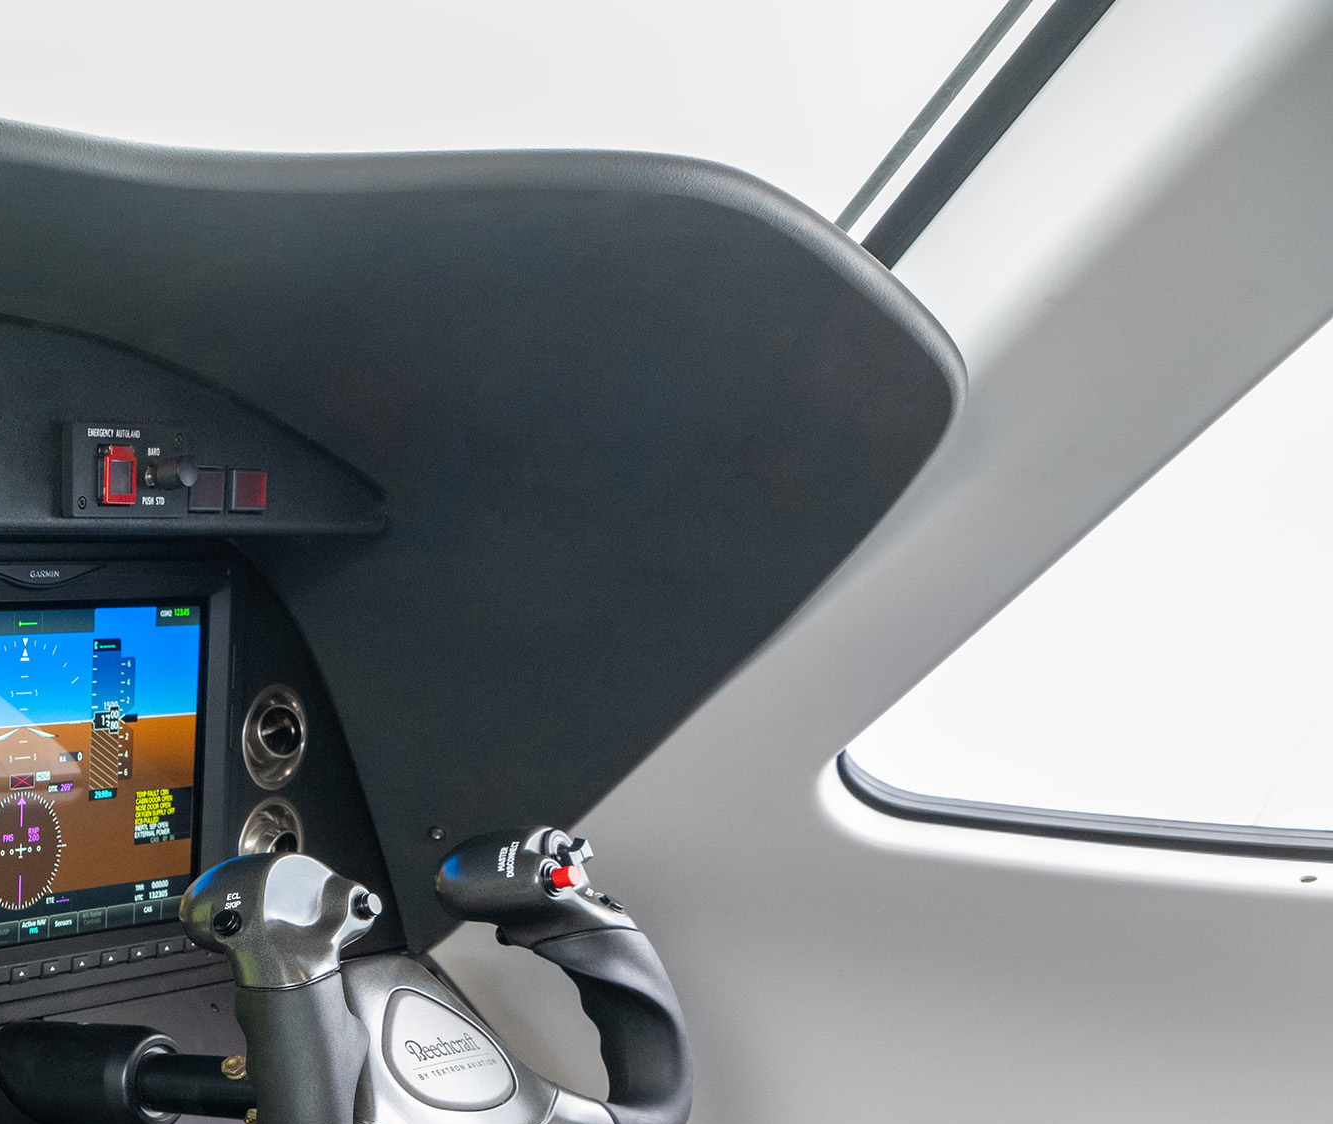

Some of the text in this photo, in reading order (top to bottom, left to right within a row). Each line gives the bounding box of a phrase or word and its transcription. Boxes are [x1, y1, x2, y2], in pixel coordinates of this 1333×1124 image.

[88, 428, 140, 438] EMERGENCY AUTOLAND
[30, 570, 59, 578] GARMIN
[226, 893, 241, 901] ECL
[225, 900, 242, 910] SKIP
[405, 1031, 481, 1063] Beechcraft
